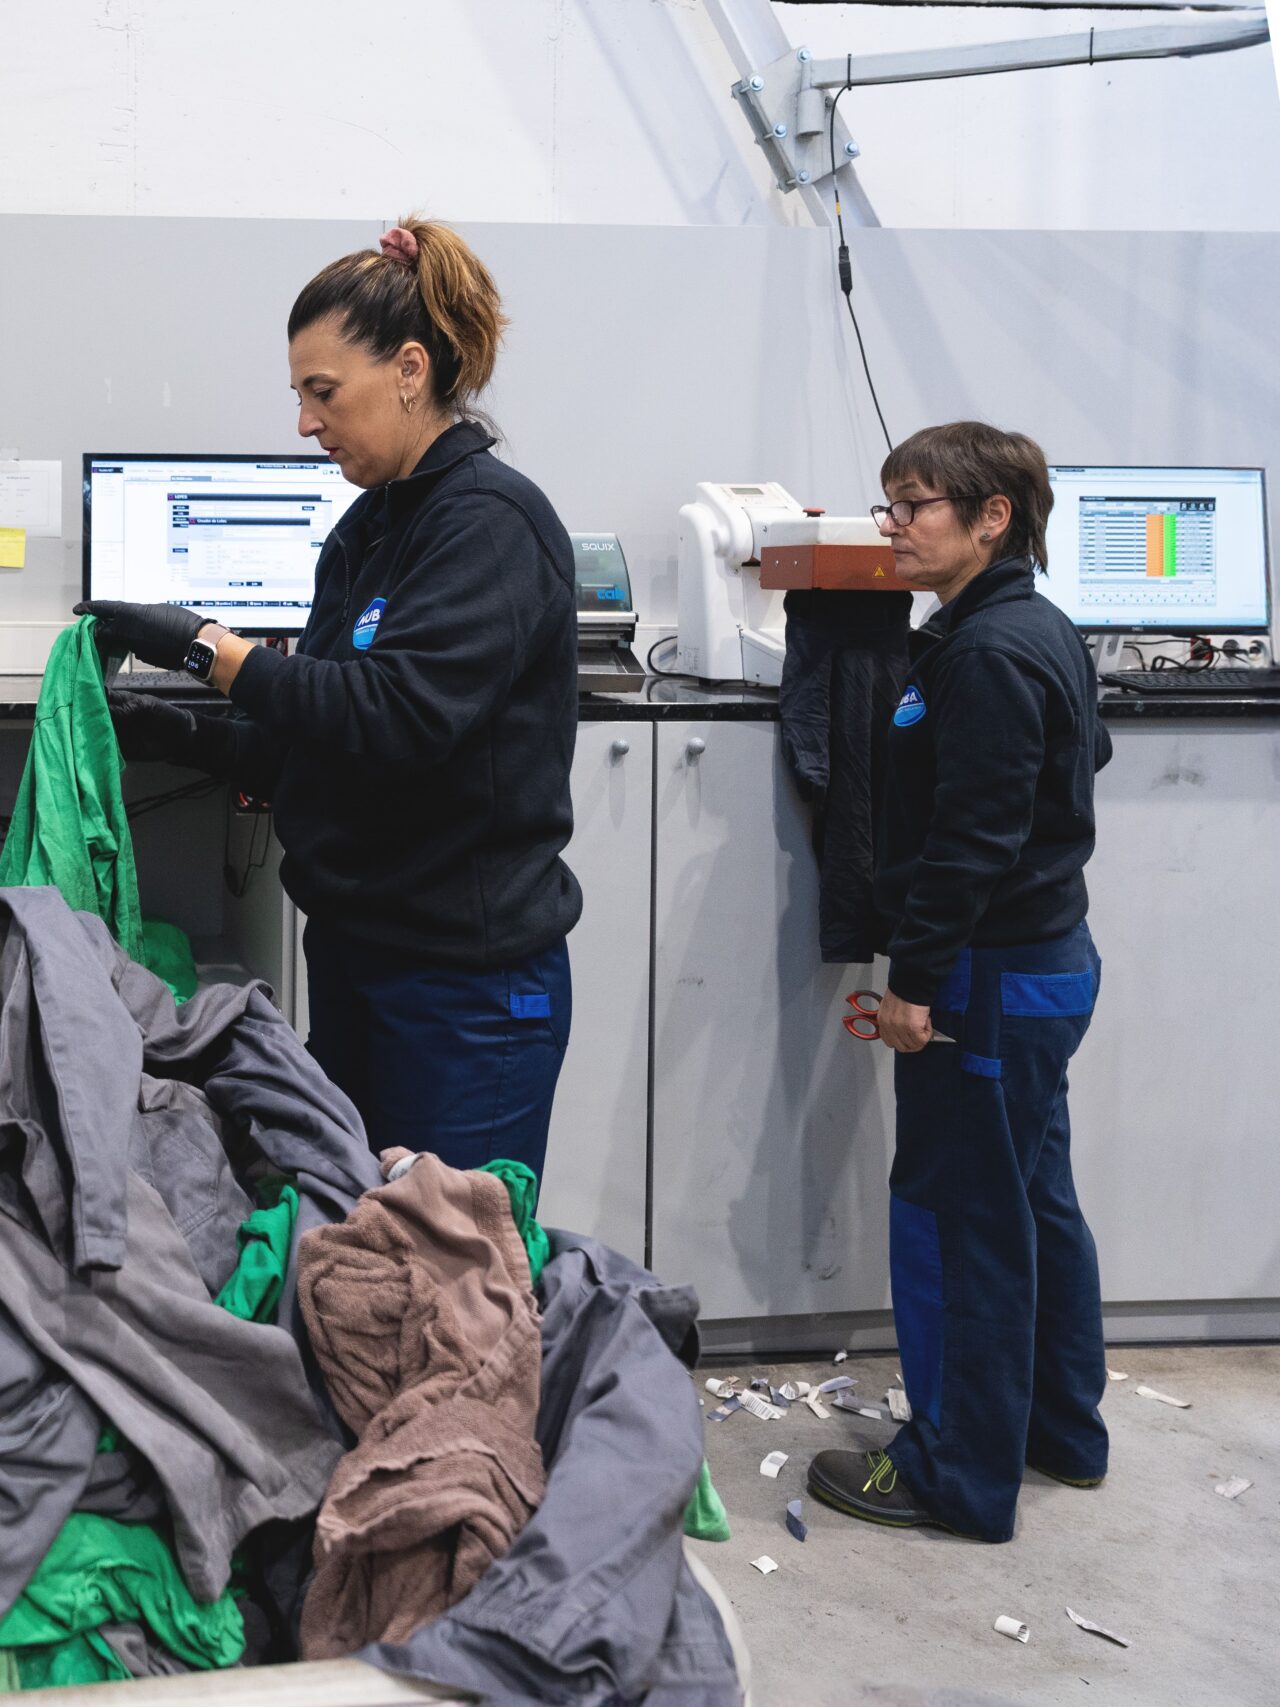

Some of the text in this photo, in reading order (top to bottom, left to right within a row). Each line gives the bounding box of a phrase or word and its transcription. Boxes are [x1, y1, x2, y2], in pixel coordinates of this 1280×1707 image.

[581, 542, 615, 551] SQUIX
[596, 587, 625, 601] cab
[357, 608, 381, 627] NUB
